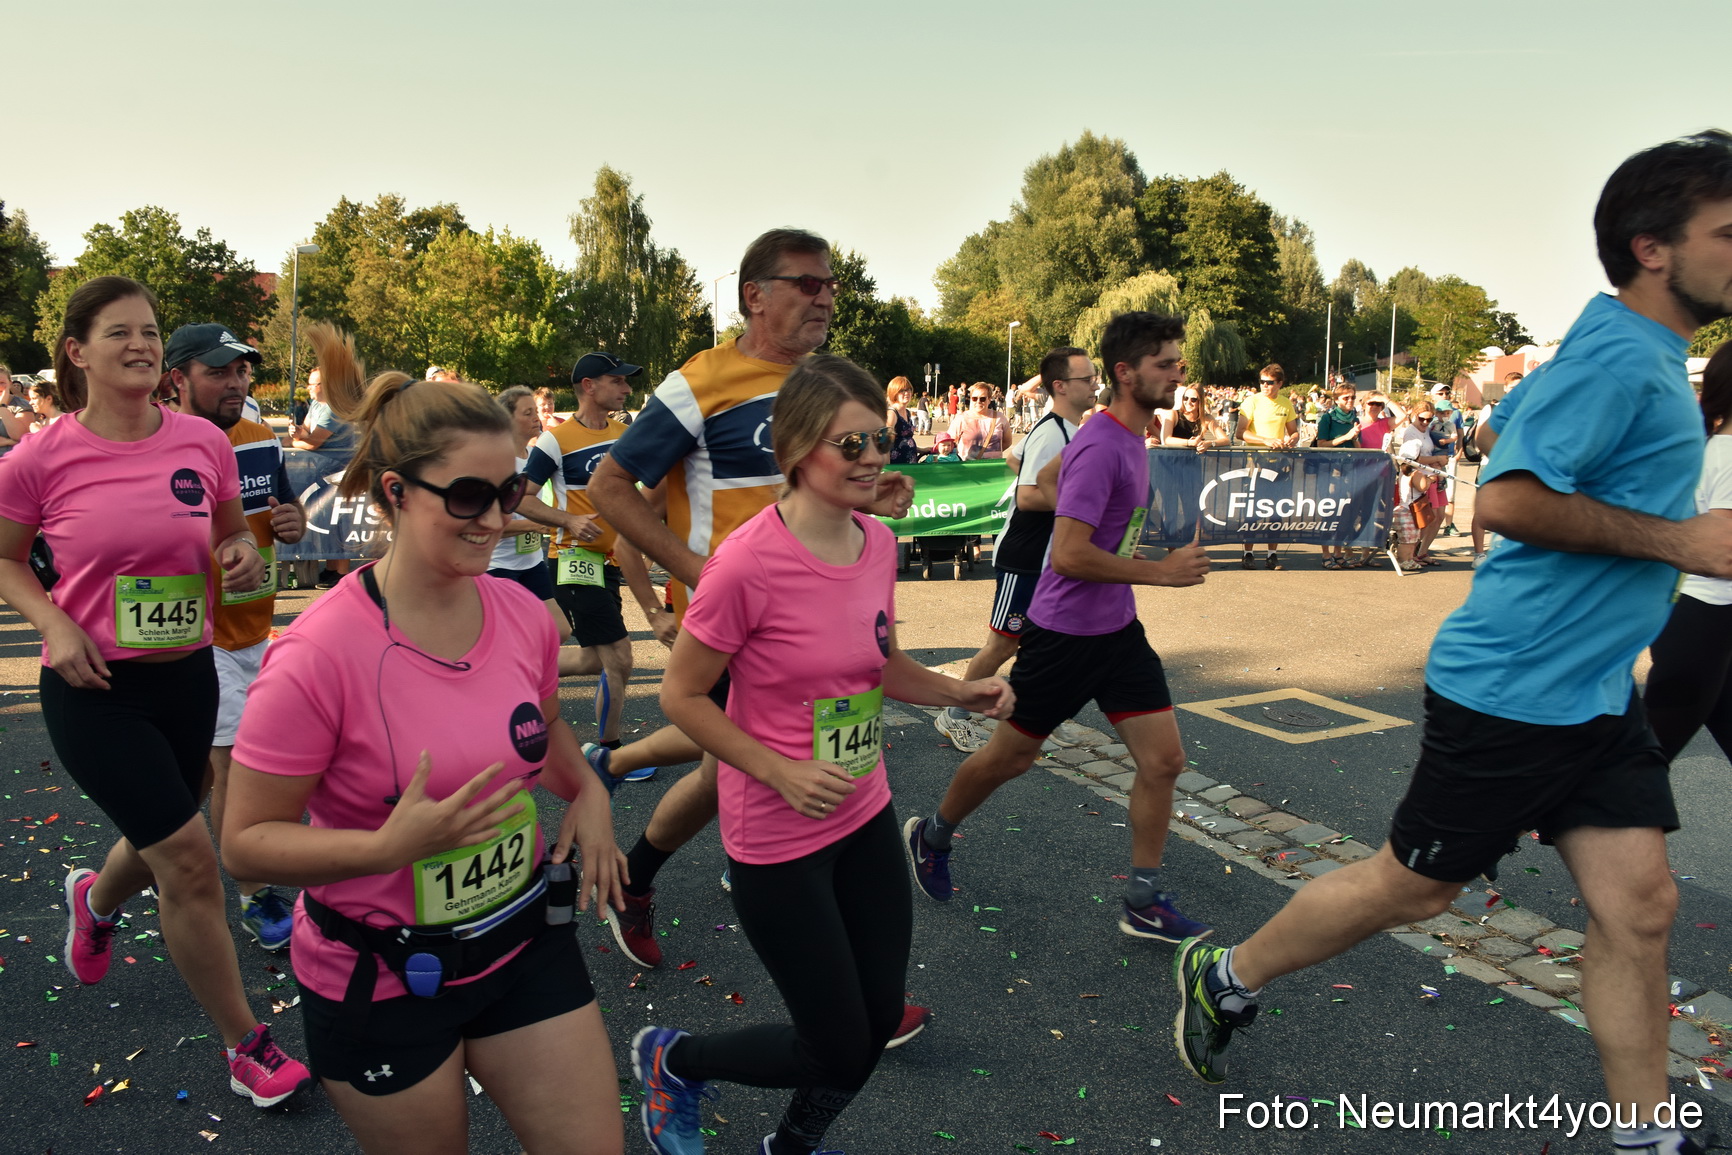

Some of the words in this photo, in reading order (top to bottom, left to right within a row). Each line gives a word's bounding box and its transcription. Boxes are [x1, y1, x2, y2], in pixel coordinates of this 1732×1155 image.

[1227, 492, 1351, 518] Fischer
[1236, 521, 1340, 533] AUTOMOBILE
[569, 561, 595, 576] 556
[129, 599, 198, 628] 1445
[171, 627, 191, 635] Margit
[828, 716, 880, 759] 1446
[435, 832, 525, 900] 1442
[444, 886, 496, 911] Gehrmann
[497, 871, 521, 891] Katrin
